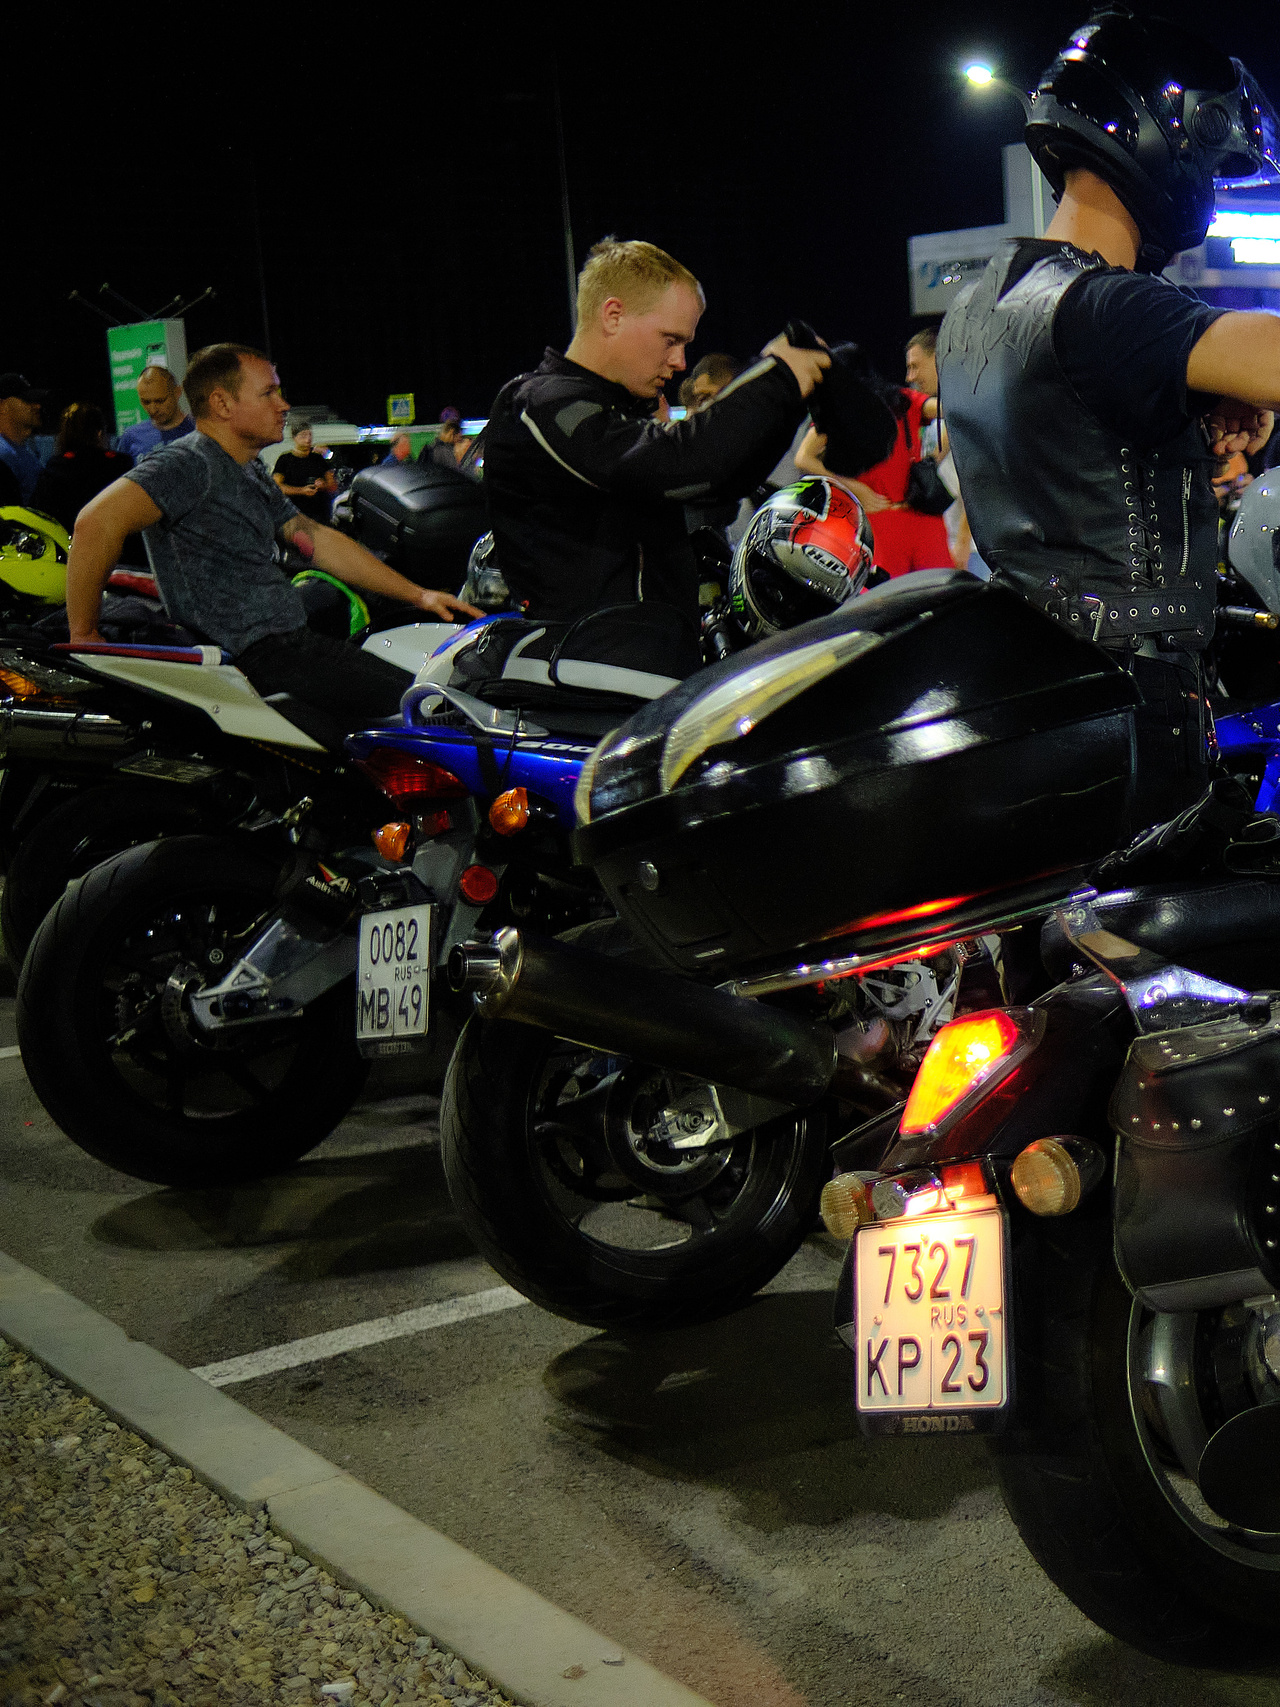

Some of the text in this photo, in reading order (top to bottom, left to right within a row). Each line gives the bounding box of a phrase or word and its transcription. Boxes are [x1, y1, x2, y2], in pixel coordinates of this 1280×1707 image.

[370, 918, 419, 965] 0082
[394, 964, 412, 982] RUS
[360, 983, 422, 1032] MB 49
[878, 1234, 976, 1304] 7327
[931, 1303, 969, 1330] RUS
[867, 1329, 990, 1397] KP 23
[902, 1415, 976, 1433] HONDA
